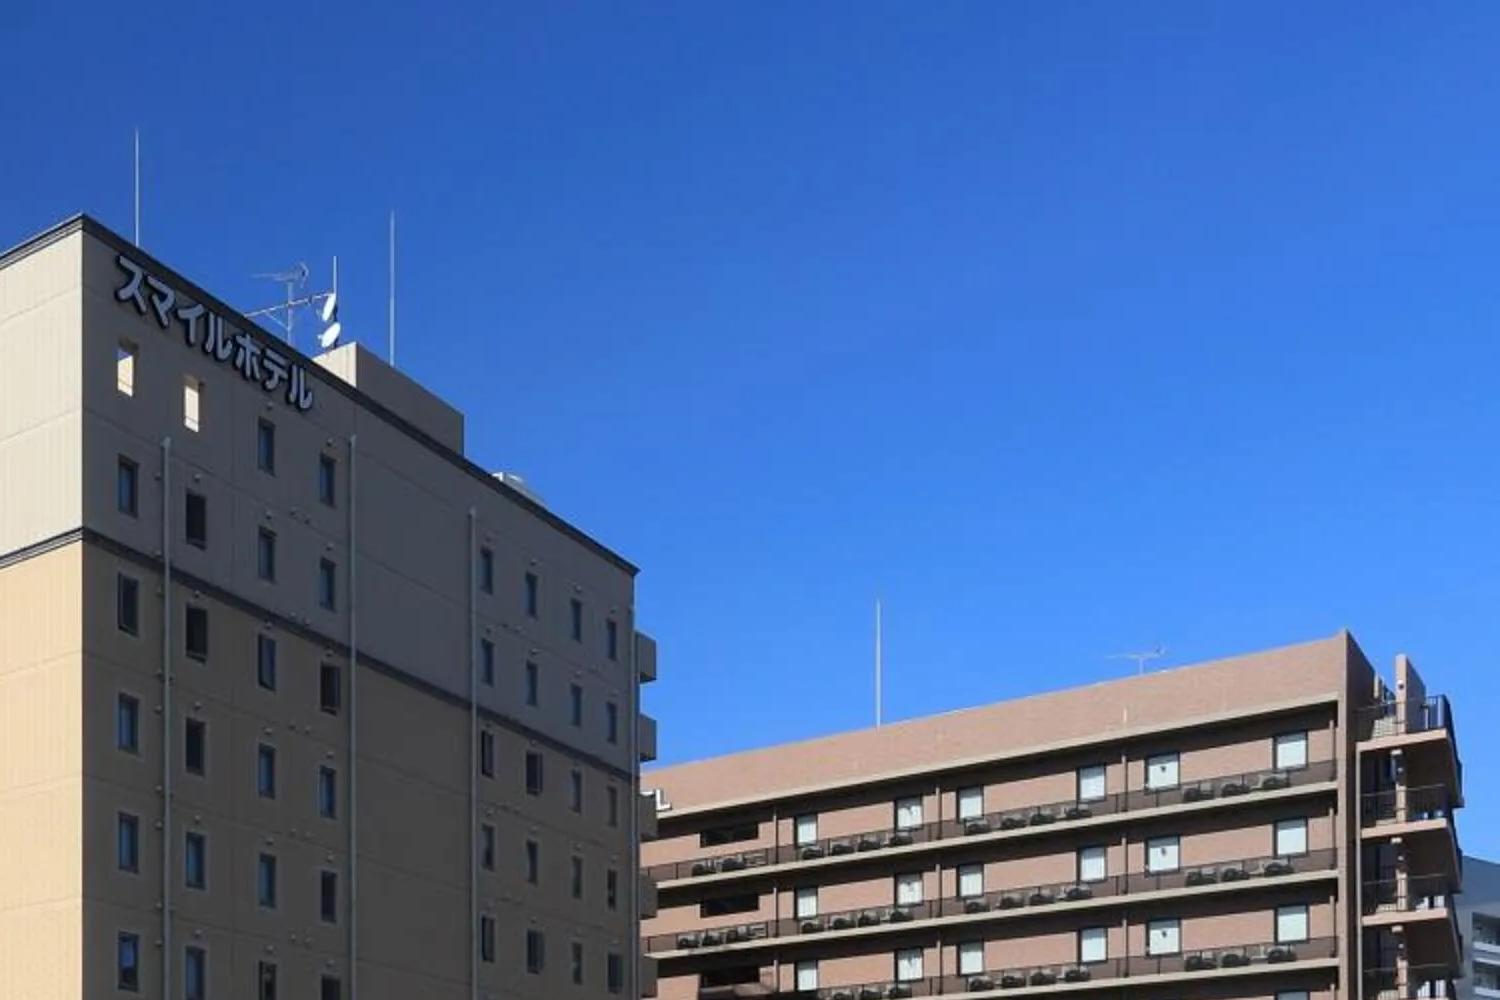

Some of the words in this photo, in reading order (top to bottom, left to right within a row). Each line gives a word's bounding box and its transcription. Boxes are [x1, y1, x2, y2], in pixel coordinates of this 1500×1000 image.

[116, 254, 313, 410] スマイルホテル
